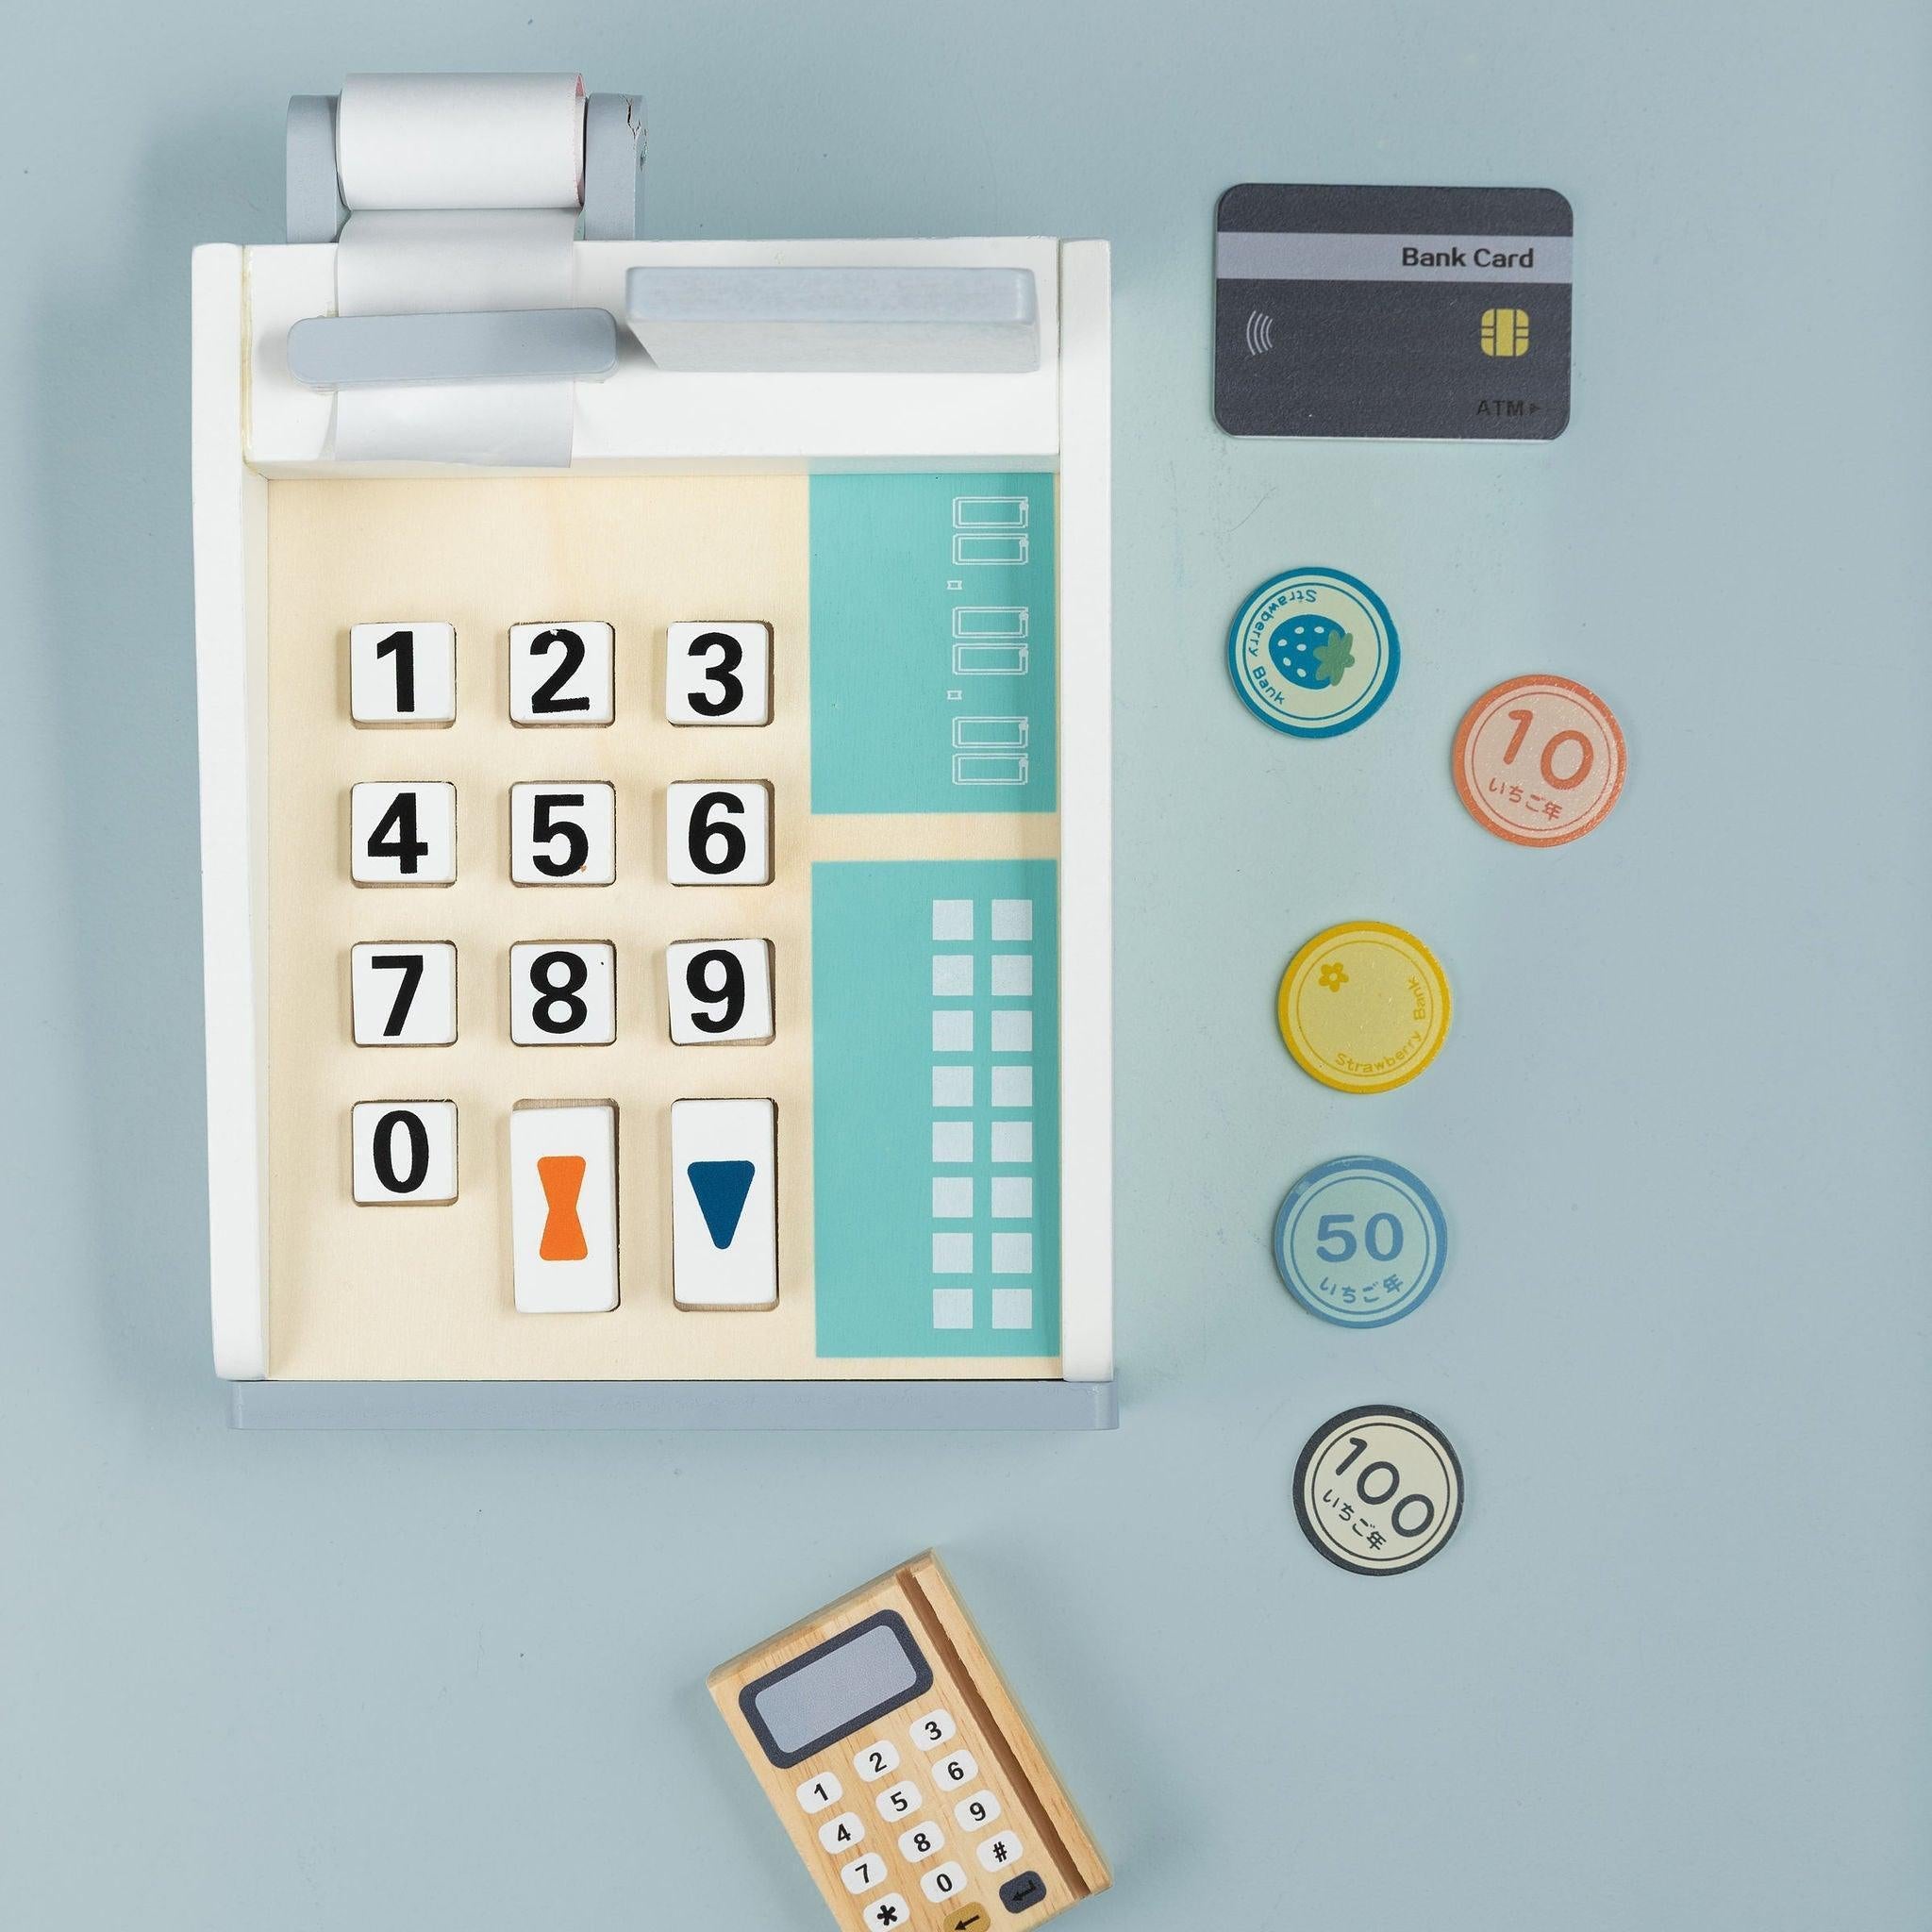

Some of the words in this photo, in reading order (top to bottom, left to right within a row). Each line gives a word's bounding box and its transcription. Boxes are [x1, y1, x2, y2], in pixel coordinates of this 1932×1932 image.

[1402, 246, 1467, 268] Bank
[1473, 247, 1535, 269] Card
[1475, 399, 1524, 416] ATM
[1248, 589, 1317, 658] Strawberry
[377, 631, 414, 712] 1
[530, 629, 590, 713] 2
[688, 632, 743, 716] 3
[1252, 665, 1286, 706] Bank
[1503, 709, 1594, 790] 10
[368, 792, 428, 874] 4
[533, 794, 589, 876] 5
[689, 791, 746, 874] 6
[1489, 777, 1563, 821] いちご年
[372, 955, 424, 1036] 7
[530, 951, 587, 1034] 8
[687, 950, 744, 1033] 9
[1335, 1030, 1423, 1073] Strawberry
[1408, 976, 1426, 1021] Bank
[374, 1110, 429, 1193] 0
[1316, 1212, 1404, 1262] 50
[1320, 1274, 1404, 1304] いちご年
[1323, 1489, 1387, 1550] いちご年
[1335, 1437, 1435, 1538] 100
[813, 1783, 829, 1802] 1
[869, 1752, 888, 1774] 2
[924, 1721, 942, 1740] 3
[837, 1824, 852, 1842] 4
[891, 1791, 908, 1812] 5
[947, 1761, 964, 1781] 6
[855, 1863, 870, 1884] 7
[913, 1832, 931, 1853] 8
[969, 1802, 987, 1822] 9
[936, 1873, 953, 1892] 0
